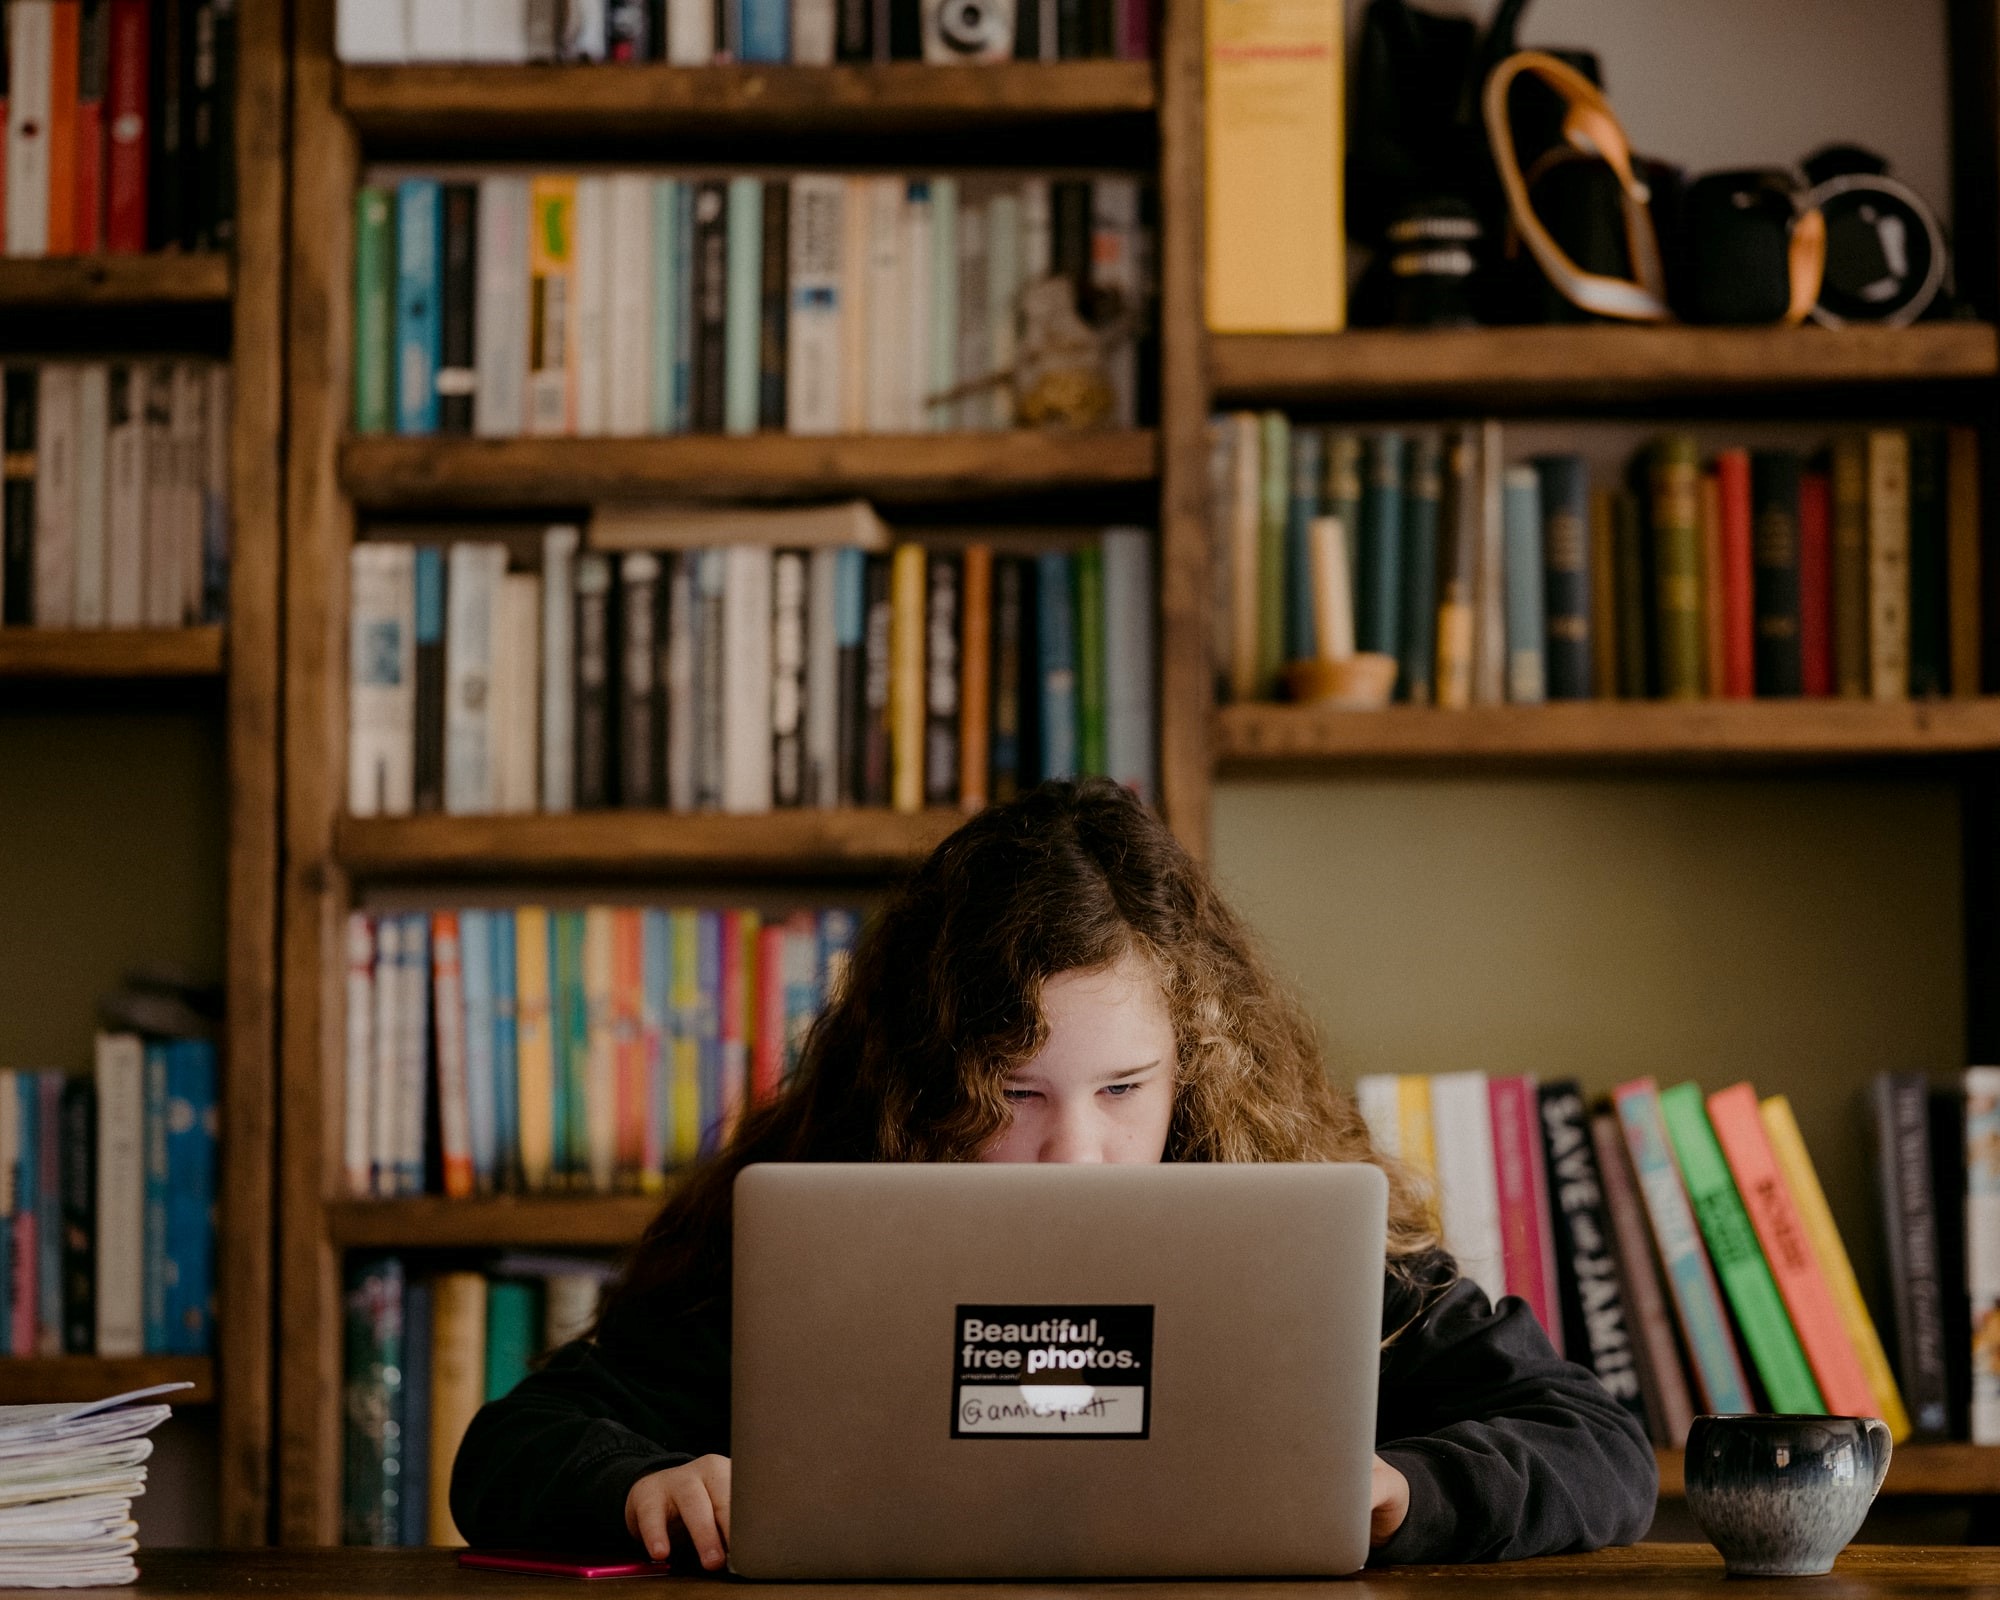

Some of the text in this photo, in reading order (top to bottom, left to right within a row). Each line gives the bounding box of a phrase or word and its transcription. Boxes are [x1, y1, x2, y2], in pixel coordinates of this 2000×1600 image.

[1541, 1094, 1602, 1212] SAVE
[1573, 1256, 1640, 1398] JAMIE
[963, 1318, 1104, 1346] Beautiful,
[961, 1344, 1141, 1374] free photos.
